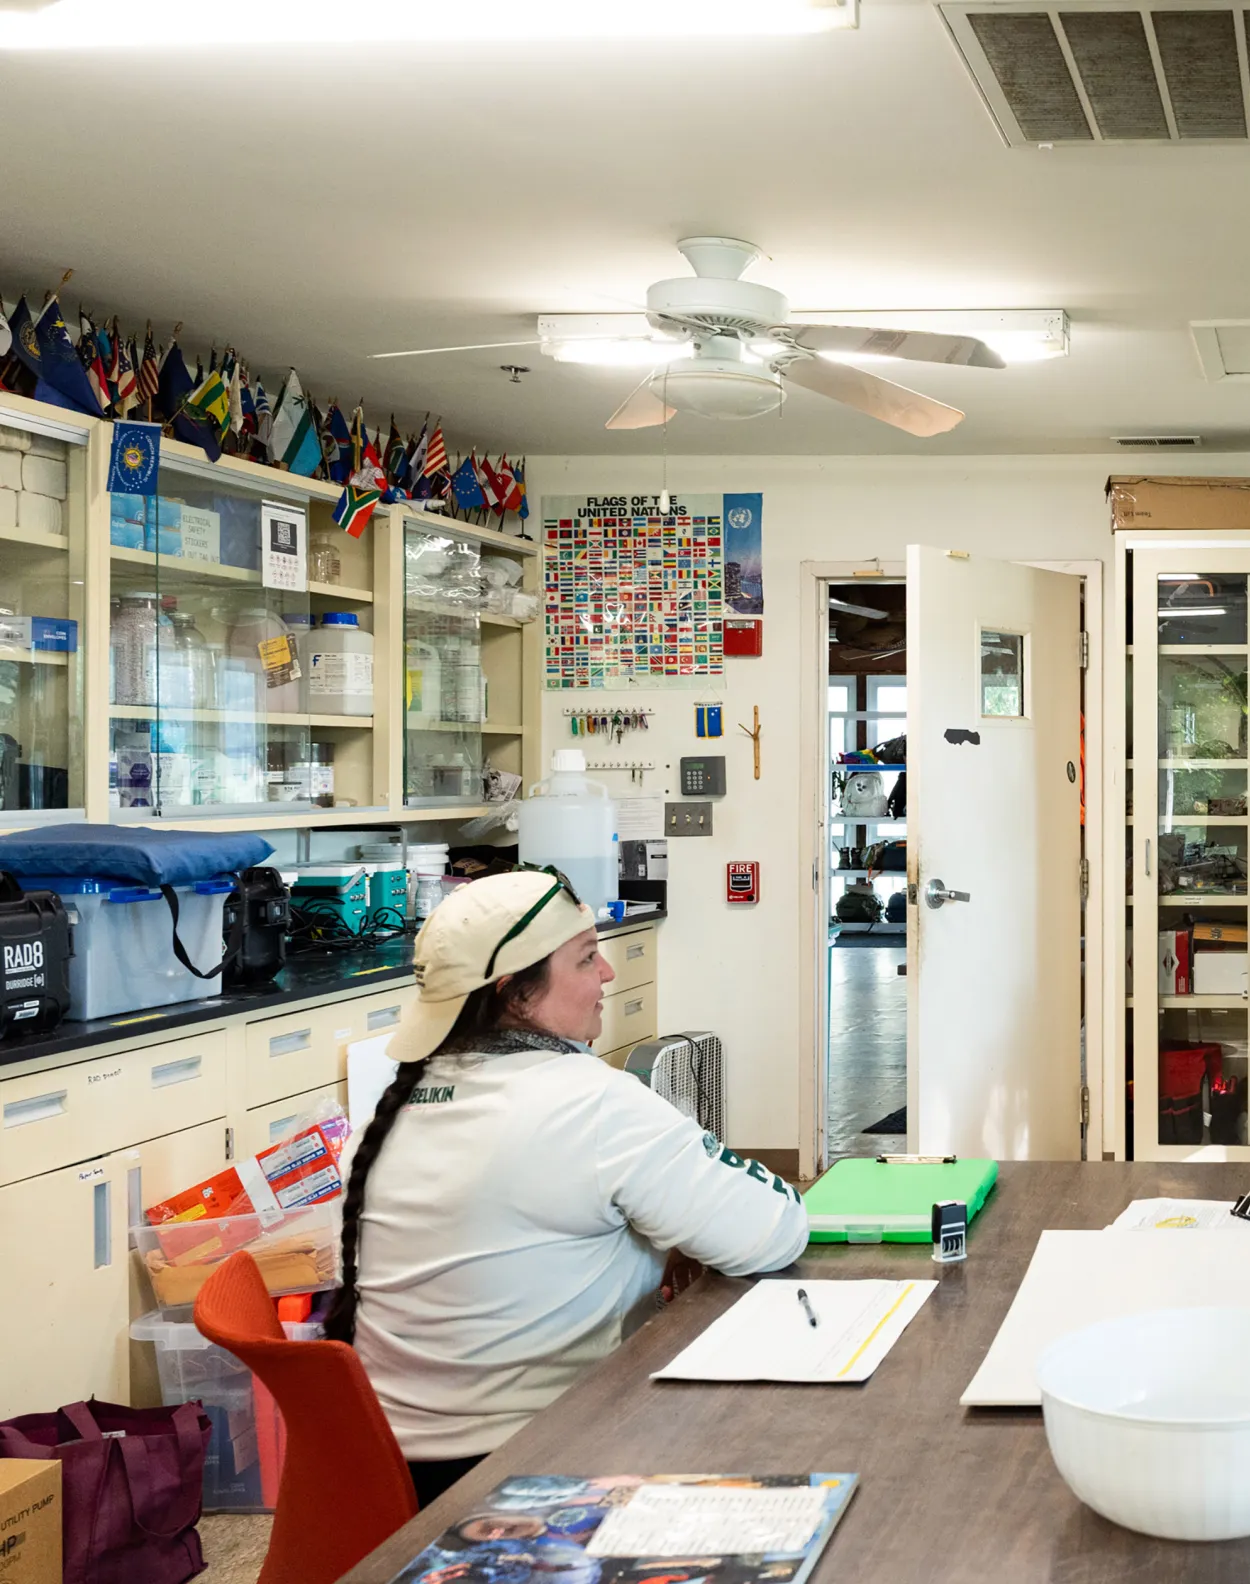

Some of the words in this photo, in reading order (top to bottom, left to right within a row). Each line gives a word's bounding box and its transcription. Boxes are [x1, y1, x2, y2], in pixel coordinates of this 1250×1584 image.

[586, 496, 628, 507] FLAGS
[631, 496, 648, 506] OF
[651, 495, 678, 506] TE
[577, 507, 628, 518] UNITED
[184, 536, 209, 548] STICKERS
[729, 864, 753, 873] FIRE
[4, 941, 44, 969] RAD8
[1, 1507, 31, 1532] UTILITY
[32, 1494, 55, 1514] PUMP
